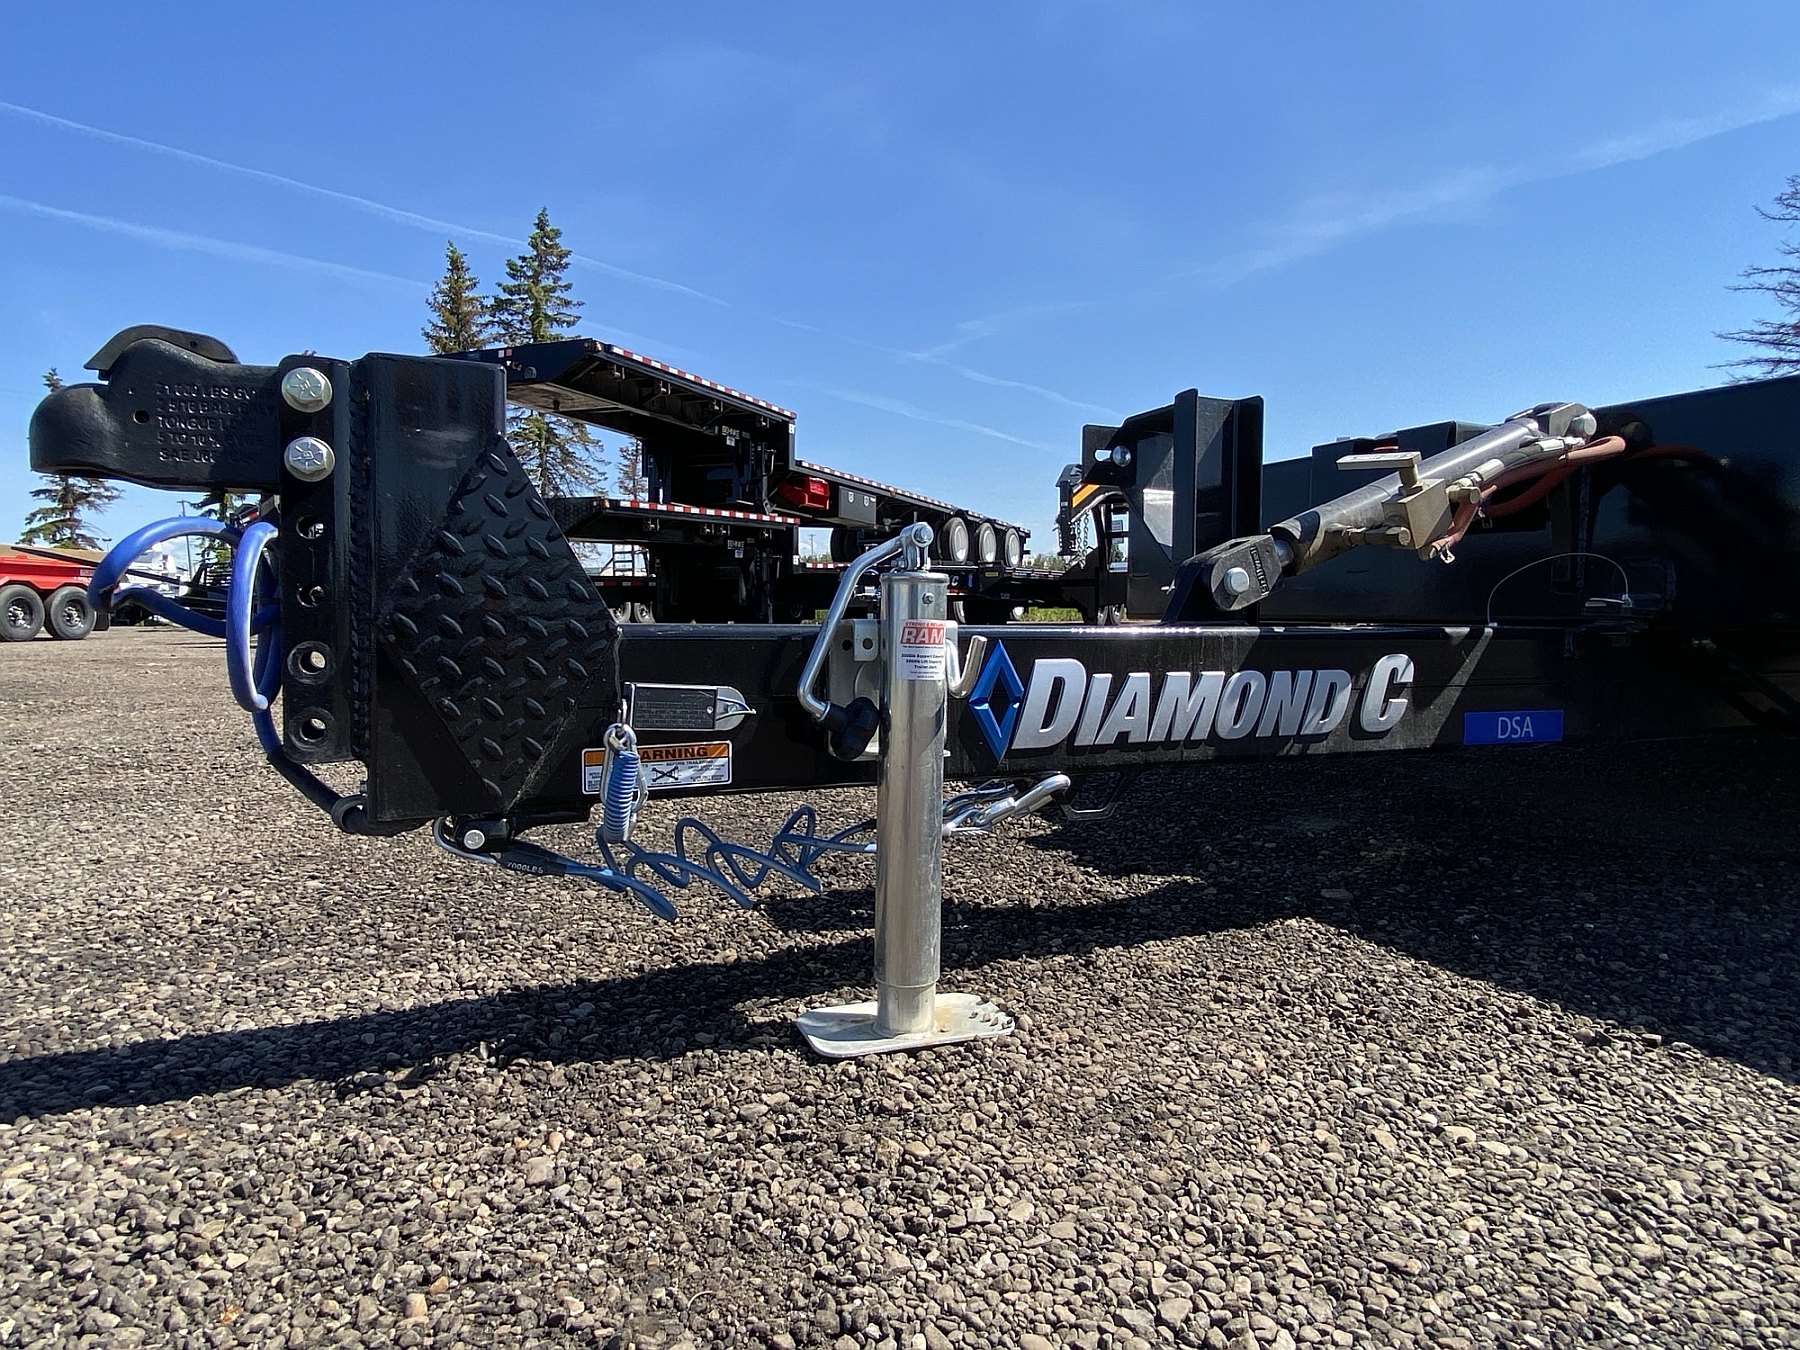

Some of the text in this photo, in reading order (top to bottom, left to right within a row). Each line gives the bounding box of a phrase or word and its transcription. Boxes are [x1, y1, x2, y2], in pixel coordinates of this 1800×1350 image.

[902, 627, 944, 644] RAM
[1011, 653, 1415, 751] DIAMOND C
[1497, 715, 1534, 739] DSA
[640, 746, 709, 761] ARNING
